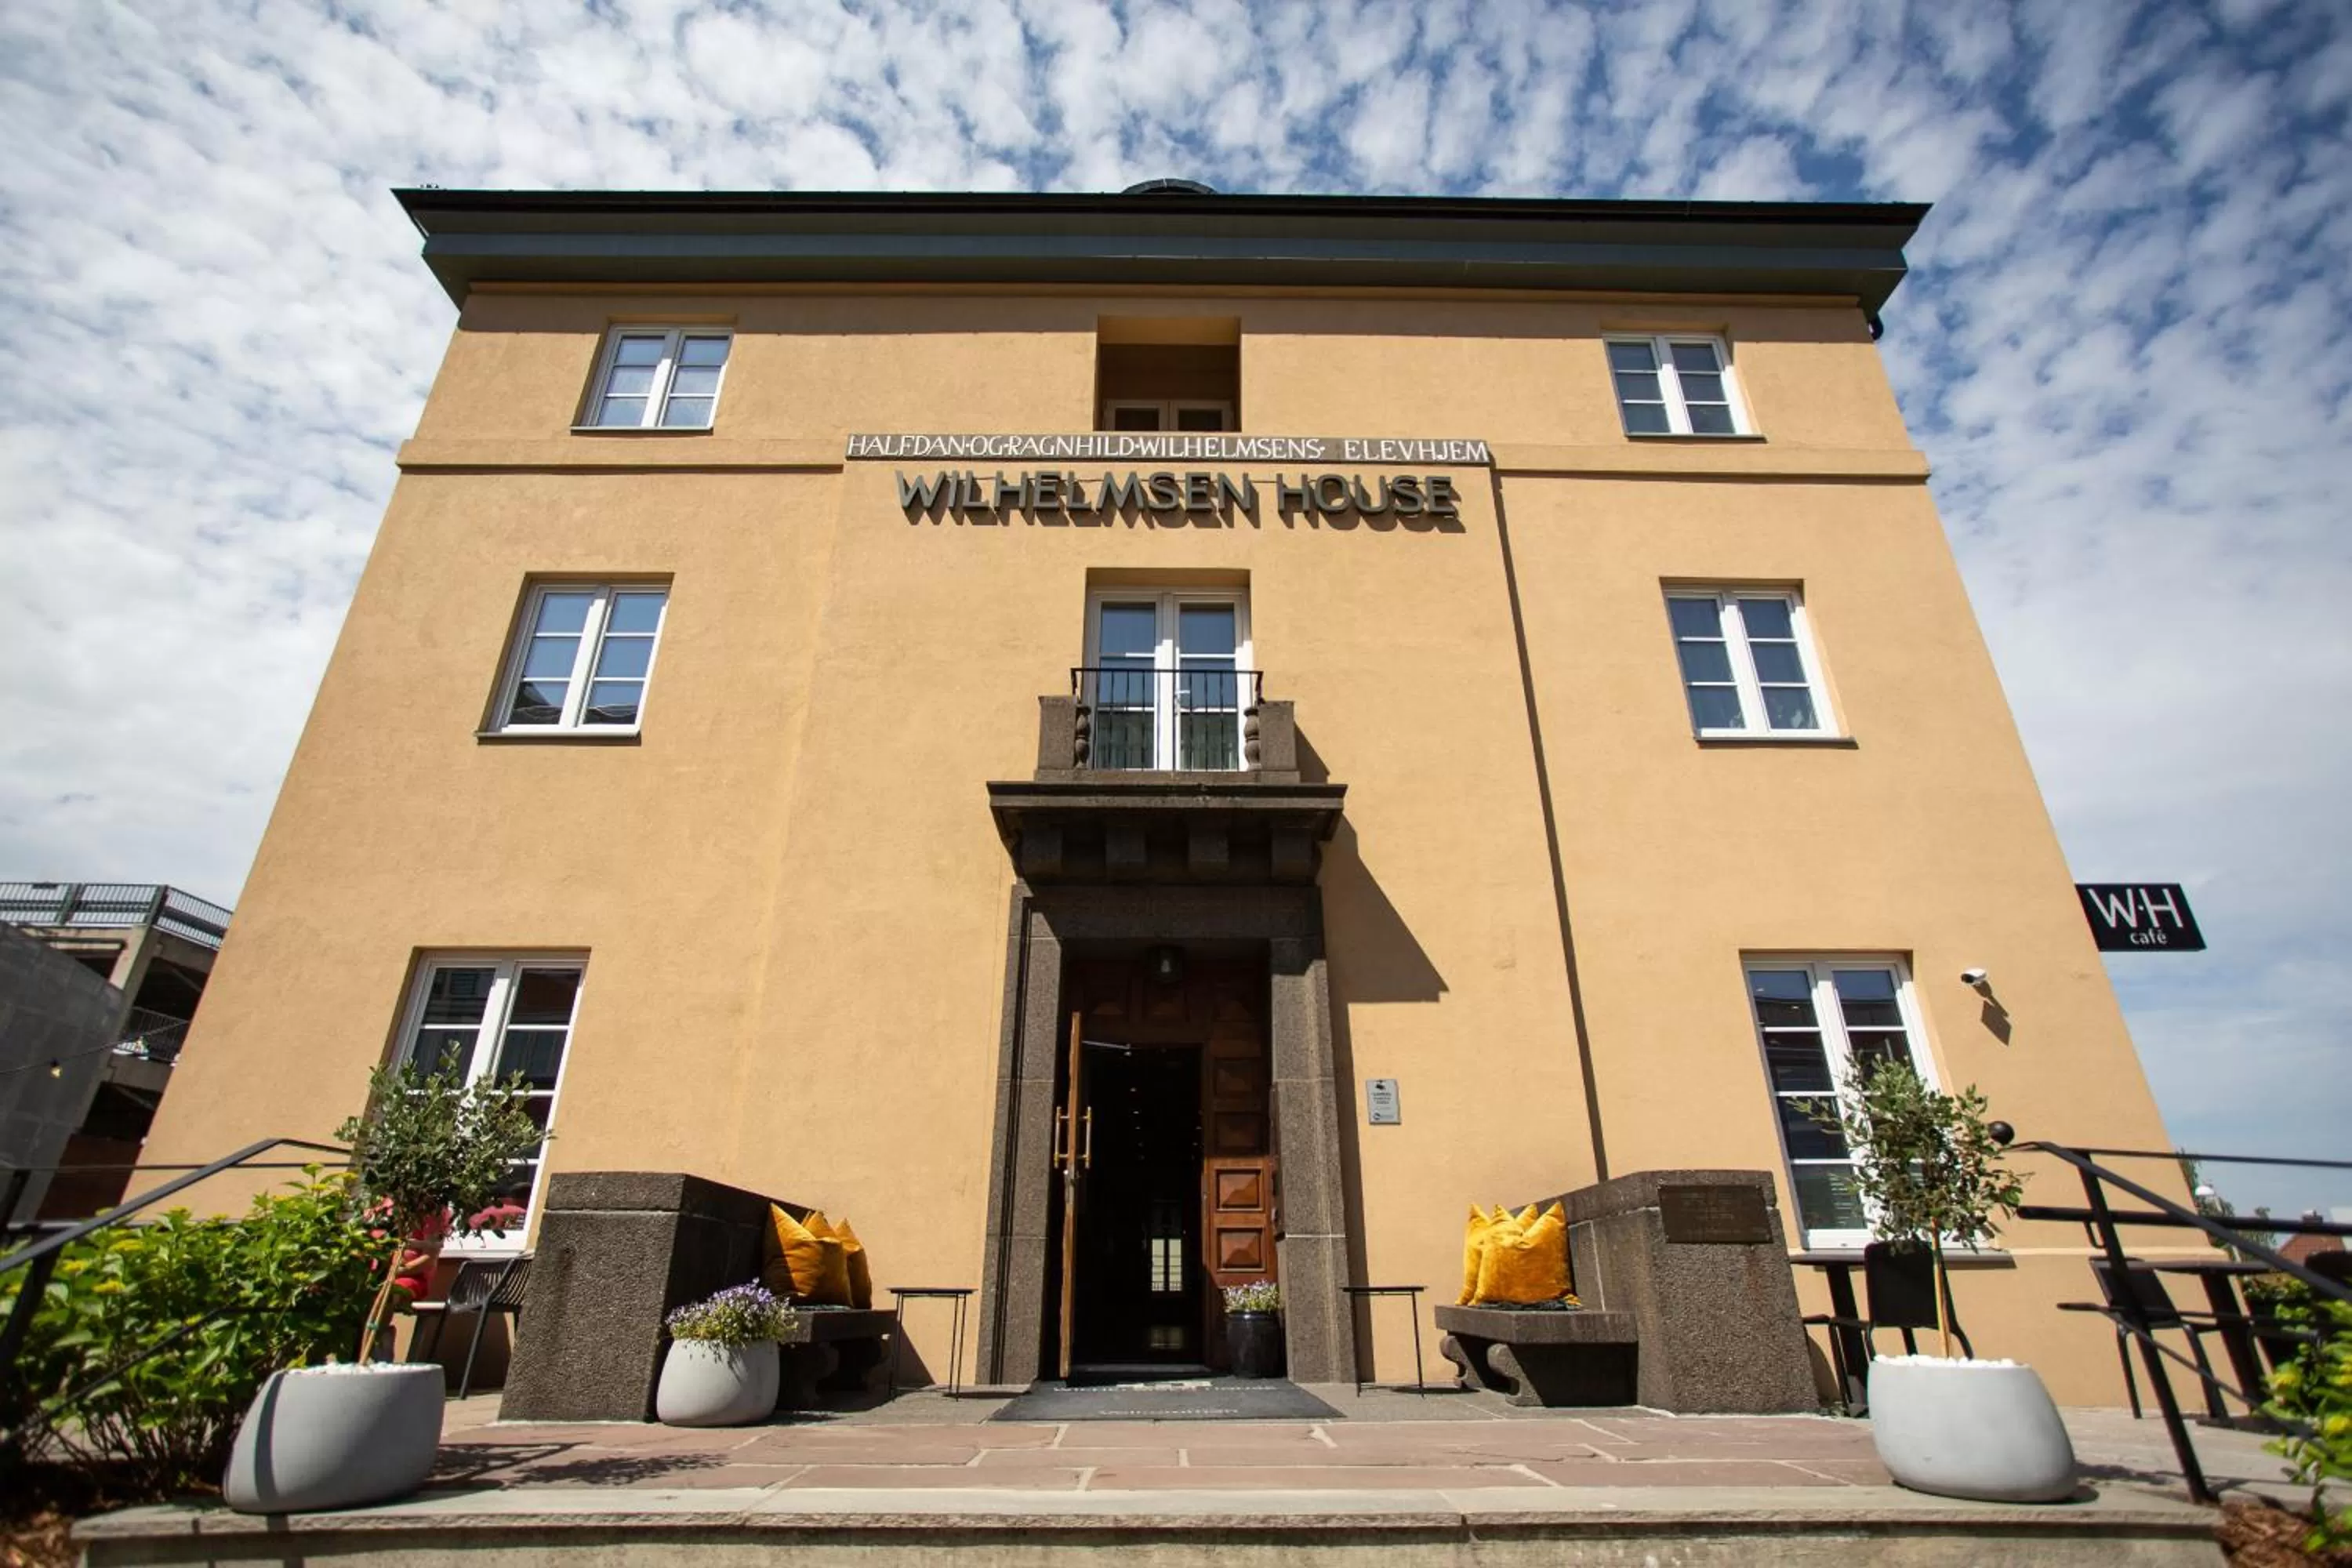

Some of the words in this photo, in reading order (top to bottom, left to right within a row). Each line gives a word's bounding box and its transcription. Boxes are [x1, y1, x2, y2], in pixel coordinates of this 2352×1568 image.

[1343, 438, 1489, 462] ELEVHJEM
[895, 470, 1252, 513] WILHELMSEN
[1276, 472, 1457, 515] HOUSE
[2129, 927, 2168, 946] café
